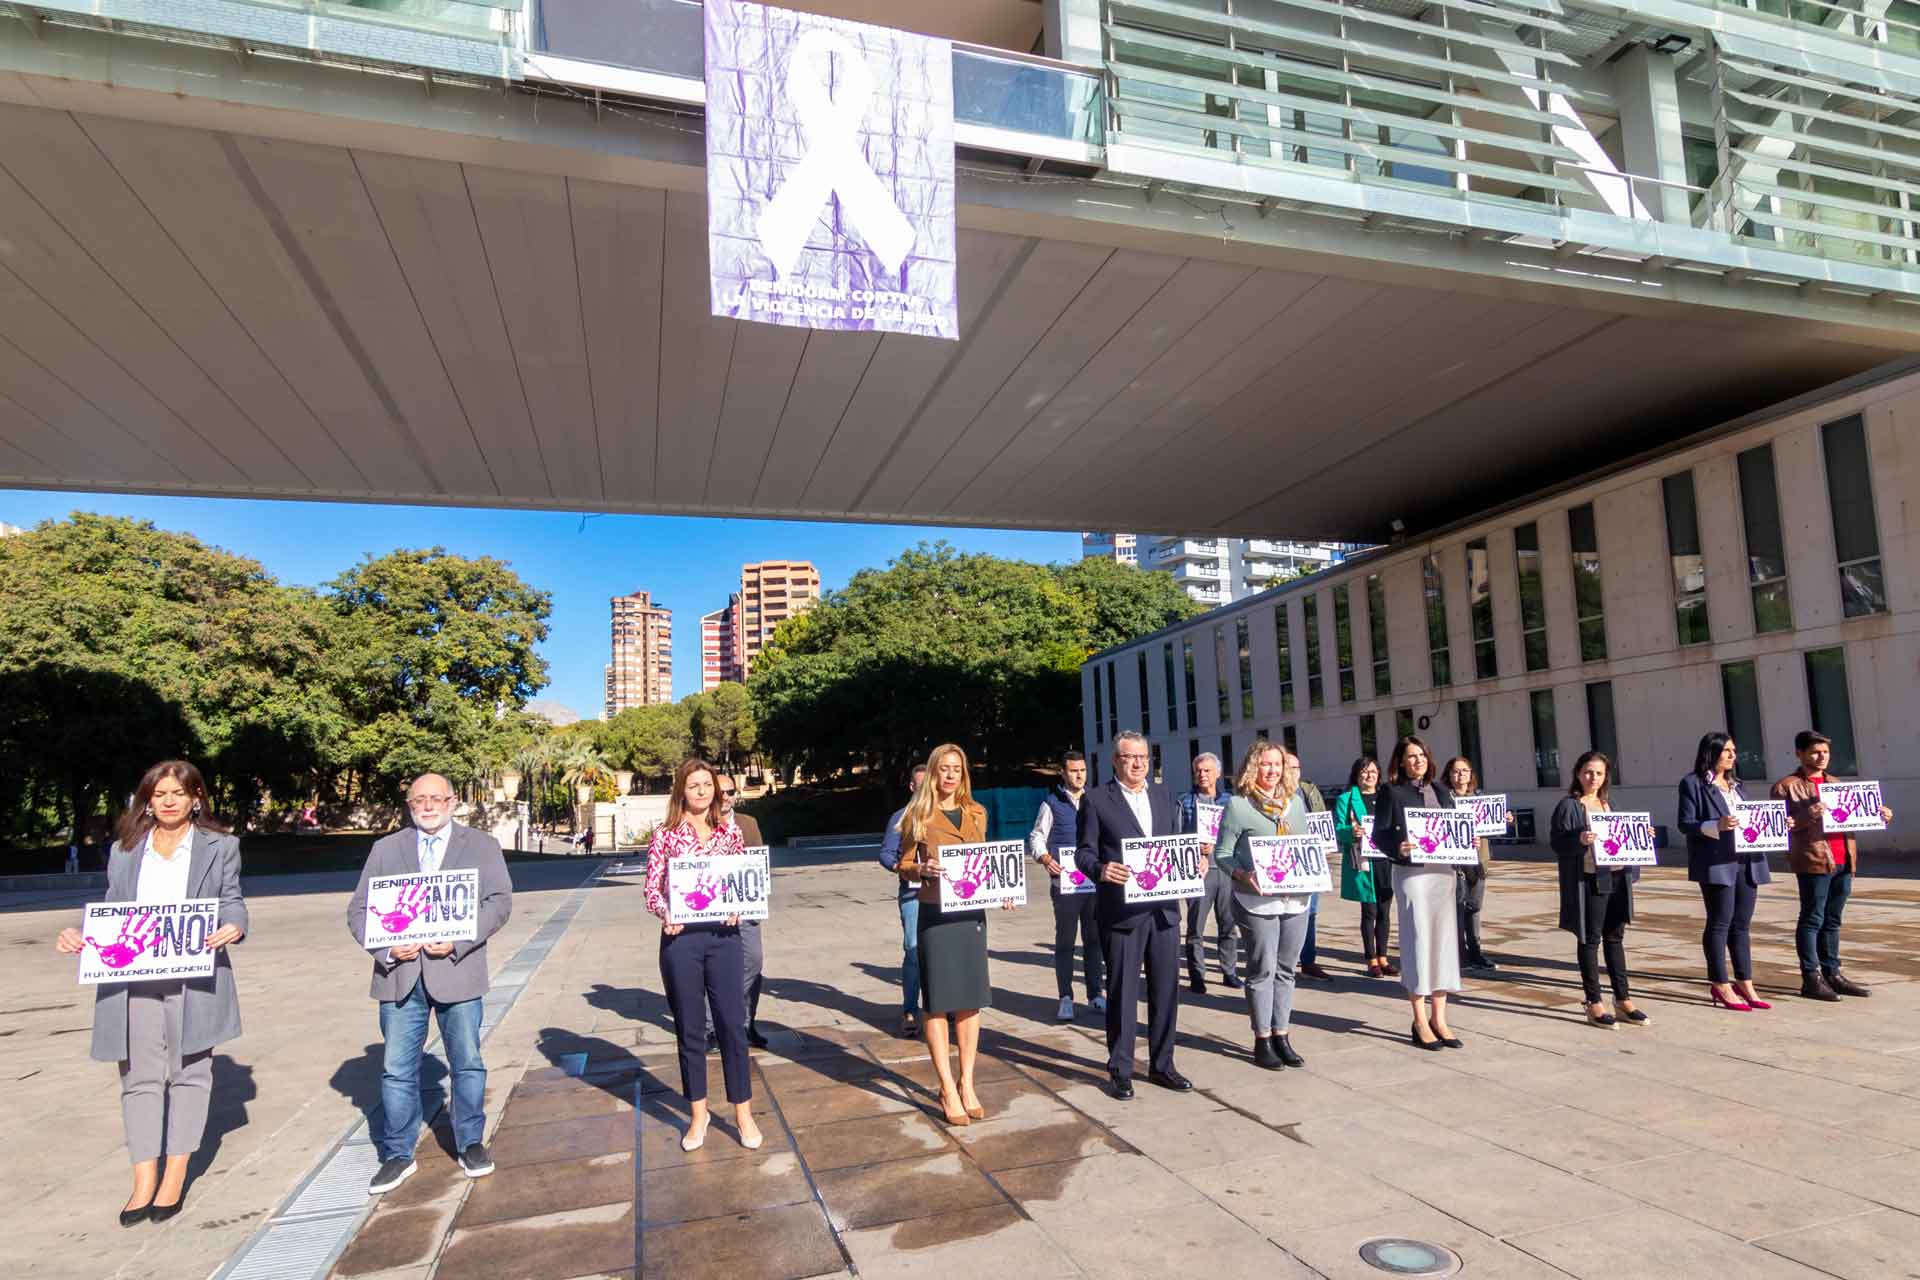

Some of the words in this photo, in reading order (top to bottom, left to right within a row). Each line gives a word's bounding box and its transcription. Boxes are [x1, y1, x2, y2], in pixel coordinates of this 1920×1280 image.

[751, 296, 845, 319] VIOLENCIA
[851, 307, 874, 320] DE
[942, 845, 998, 858] BENIDORM
[1000, 844, 1022, 853] DICE
[1125, 838, 1178, 851] BENIDORM
[1179, 837, 1198, 846] DICE
[985, 853, 1024, 890] ¡NO!
[1165, 846, 1202, 882] ¡NO!
[372, 875, 443, 890] BENIDORM
[446, 873, 476, 883] DICE
[90, 904, 177, 918] BENIDORM
[180, 903, 215, 913] DICE
[424, 882, 475, 924] ¡NO!
[153, 914, 214, 957] ¡NO!
